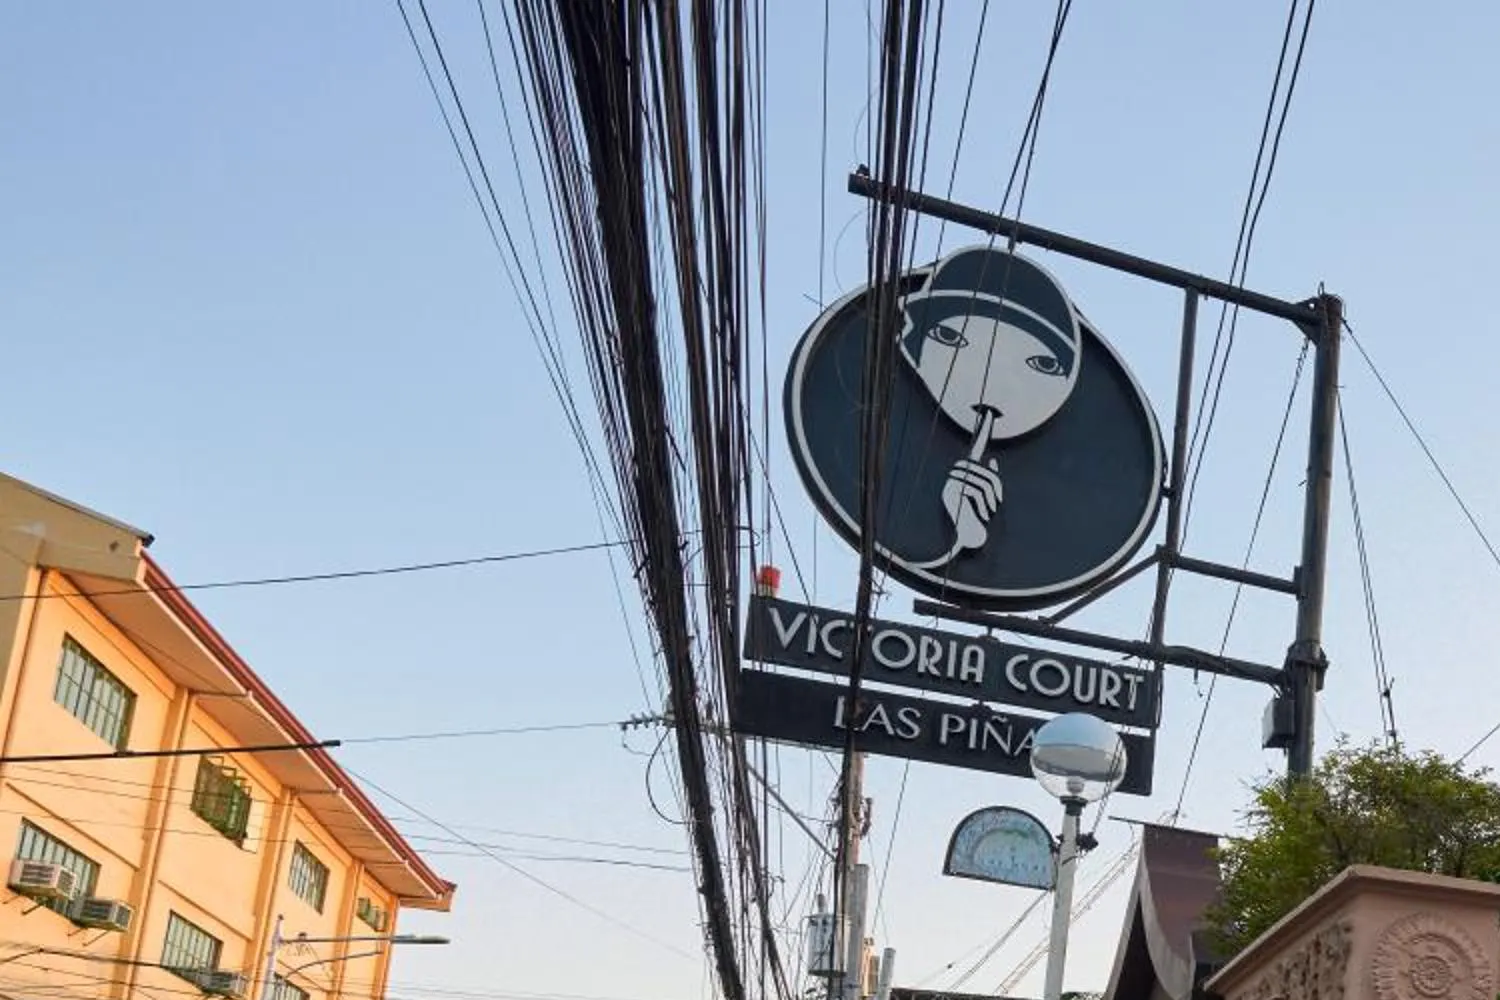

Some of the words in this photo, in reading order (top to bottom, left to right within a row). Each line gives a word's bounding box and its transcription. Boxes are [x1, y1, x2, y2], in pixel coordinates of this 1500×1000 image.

[768, 606, 985, 684] VICORIA
[1005, 653, 1145, 712] COURT
[833, 696, 922, 739] LAS
[939, 713, 1035, 756] PIÑA
